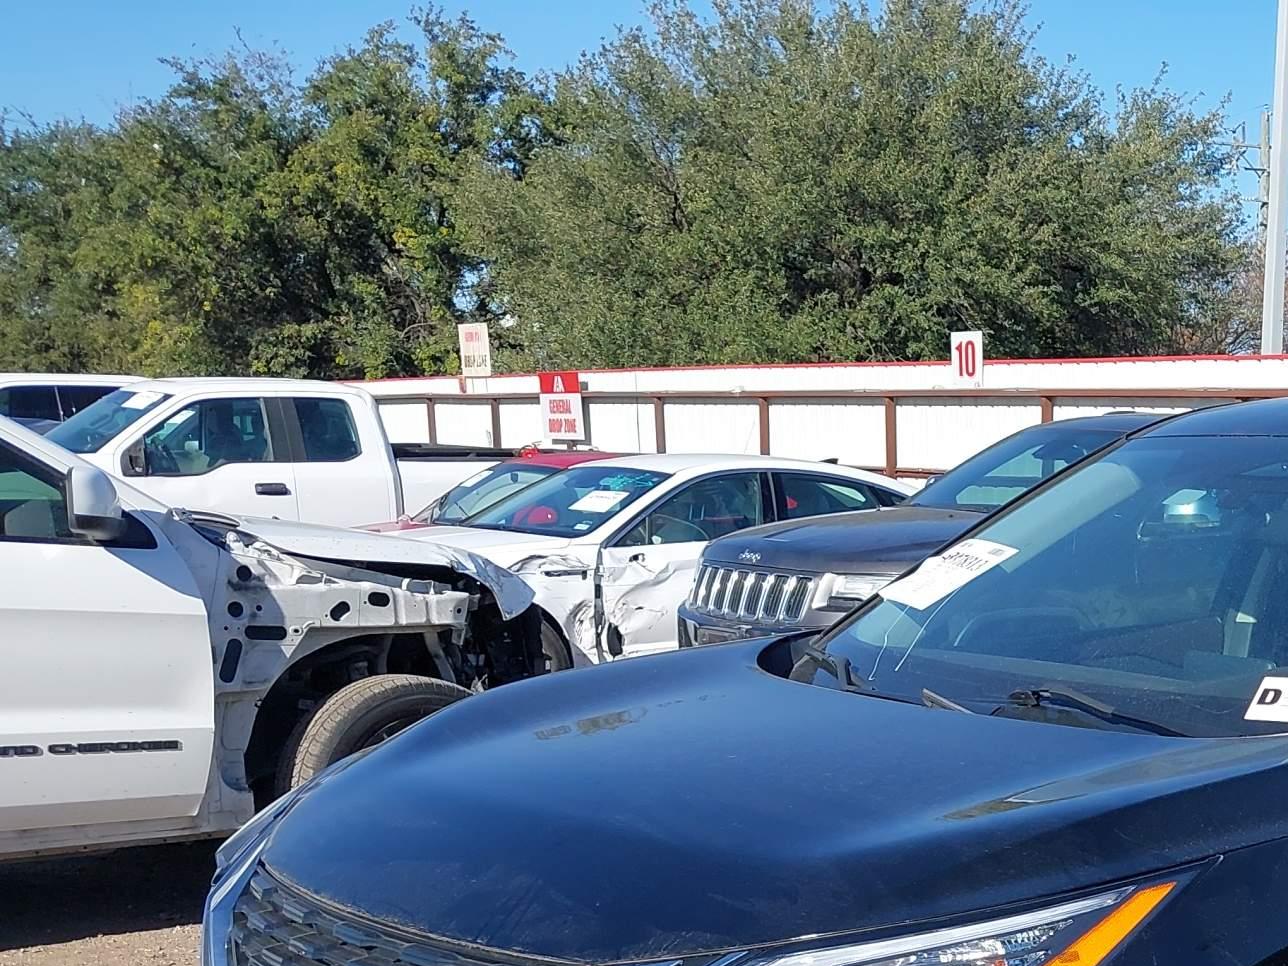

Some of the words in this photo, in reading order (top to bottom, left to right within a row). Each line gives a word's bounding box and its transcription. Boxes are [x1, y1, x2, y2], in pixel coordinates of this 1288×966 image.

[955, 340, 975, 377] 10
[548, 417, 563, 433] DROP
[564, 417, 577, 433] ZONE
[1256, 688, 1283, 705] D
